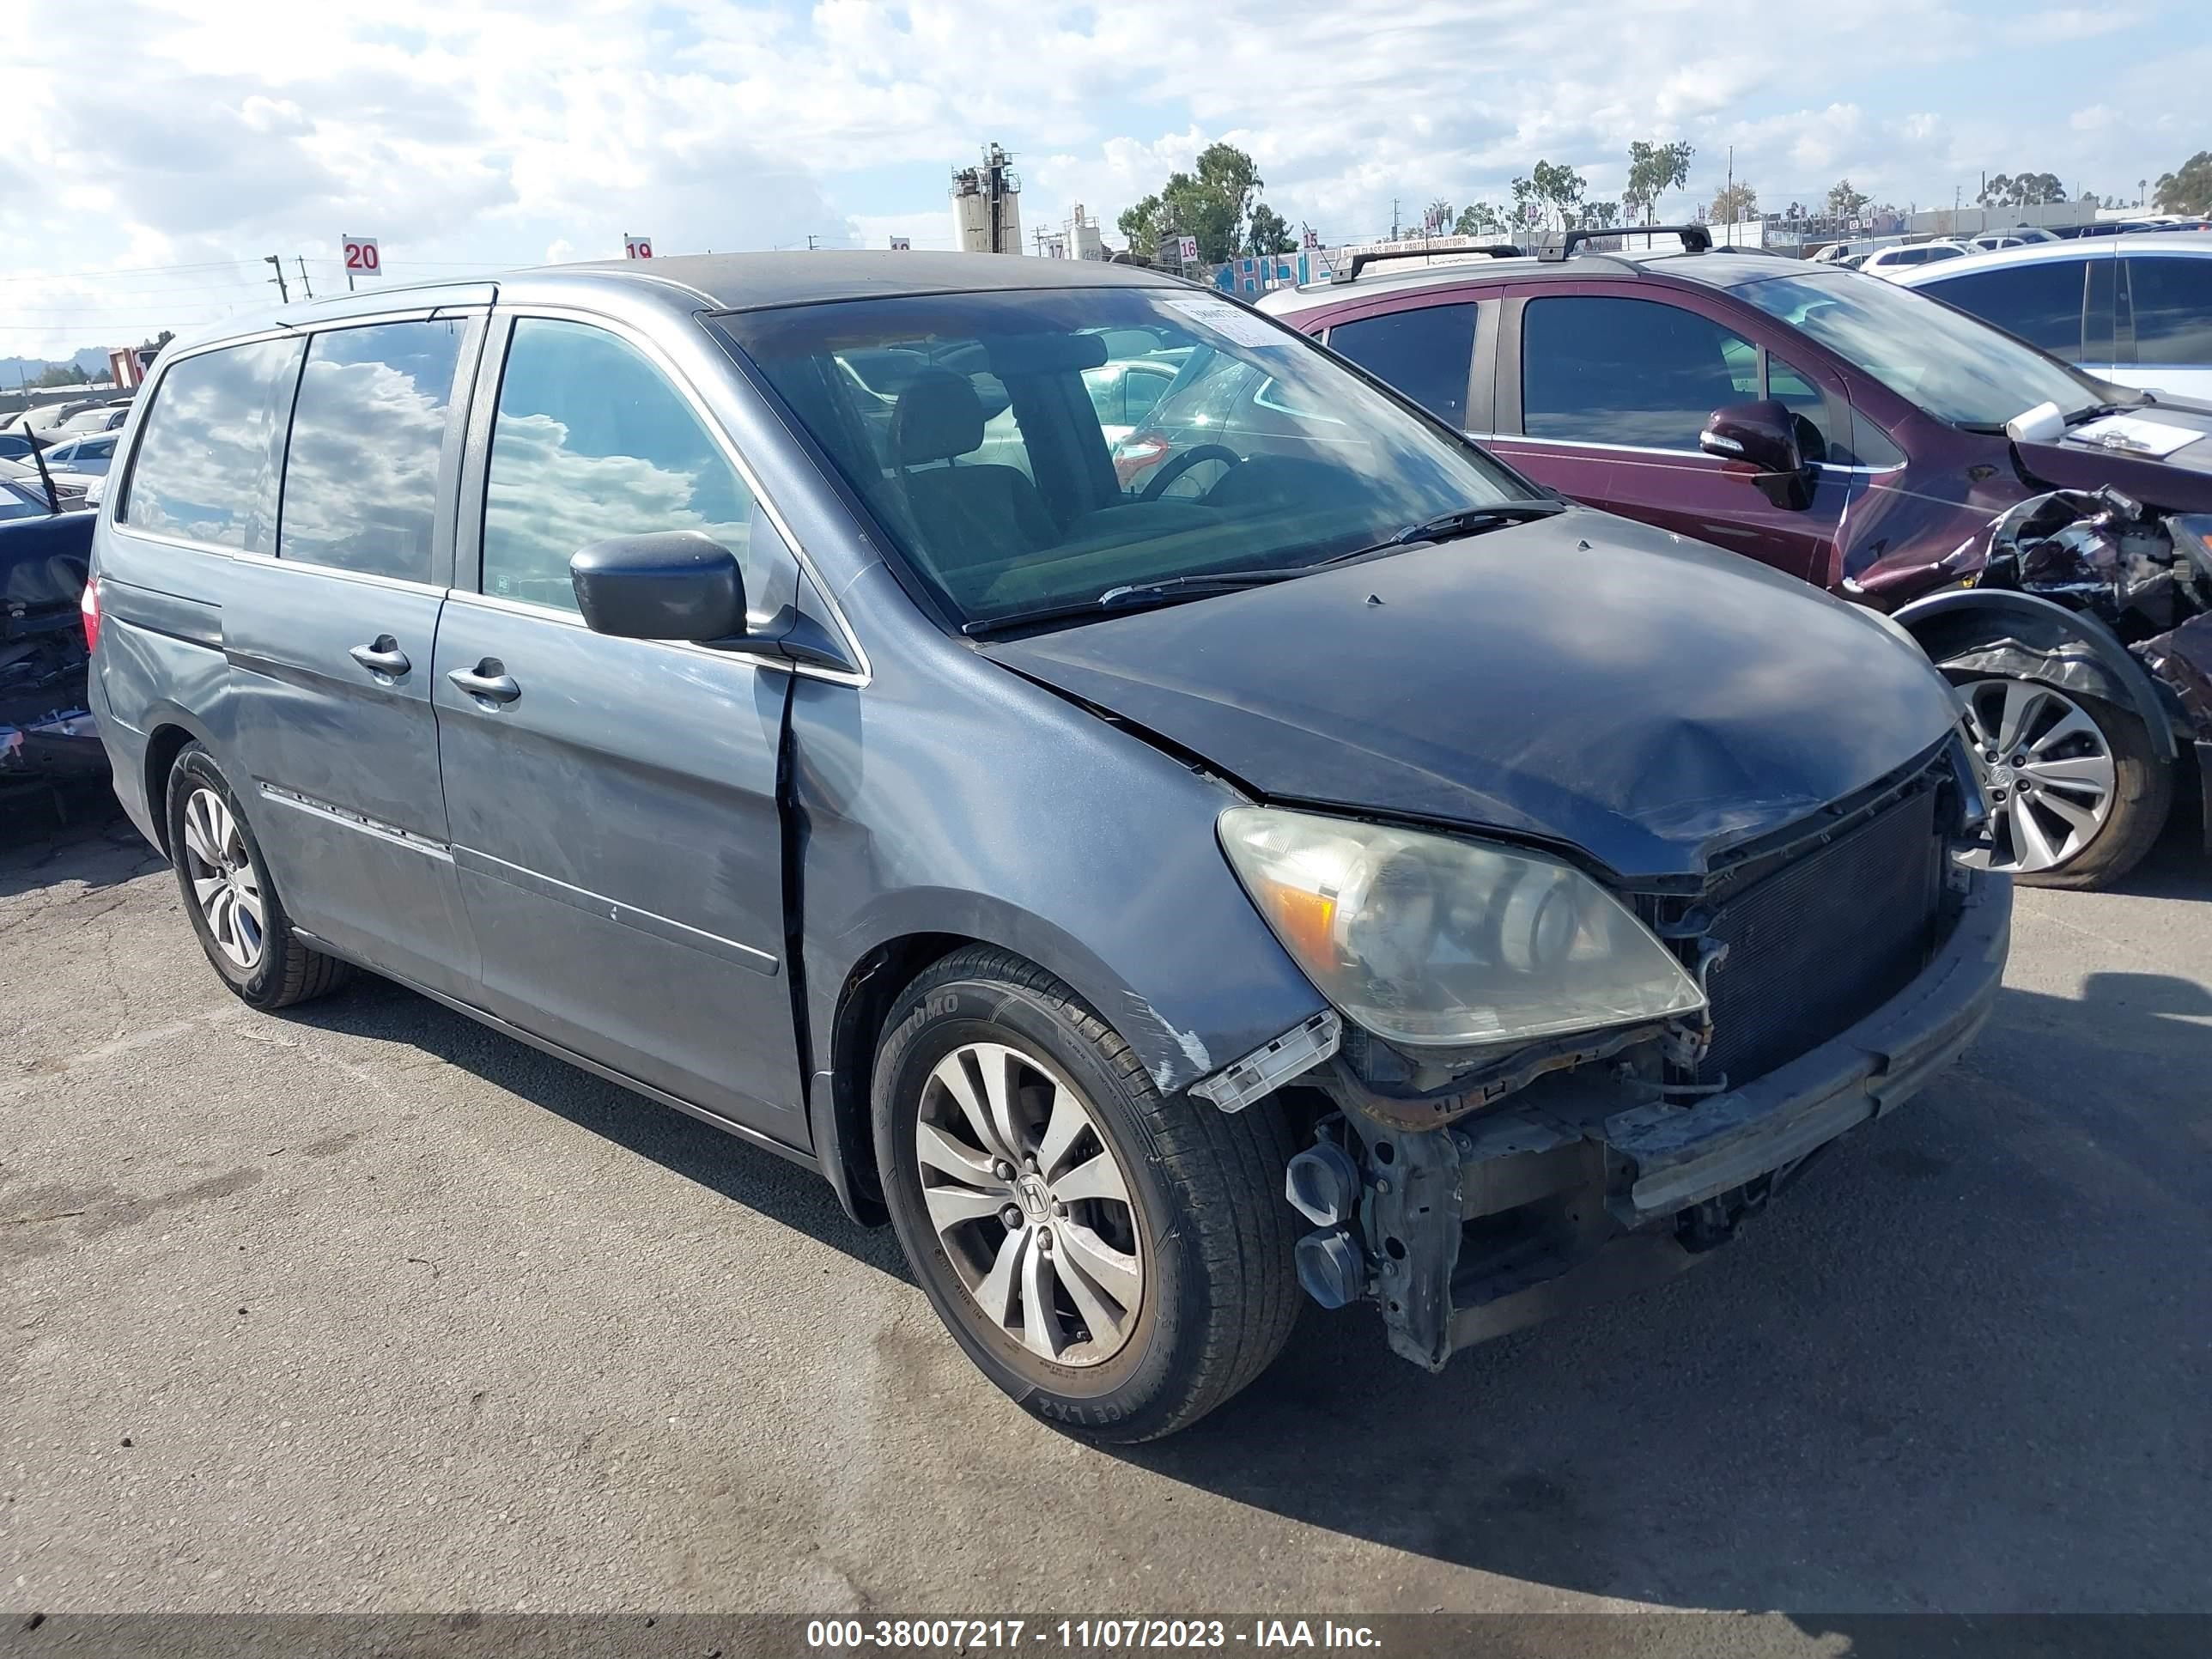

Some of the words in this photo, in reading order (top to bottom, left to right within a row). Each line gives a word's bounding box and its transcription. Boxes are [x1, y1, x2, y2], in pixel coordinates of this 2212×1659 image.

[1626, 206, 1635, 217] 12
[1425, 215, 1436, 229] 14
[1850, 221, 1857, 230] G
[1864, 220, 1870, 228] H
[1304, 234, 1317, 248] 15
[1429, 238, 1467, 248] RADIATORS
[627, 243, 652, 258] 19
[1049, 245, 1064, 258] 17
[1182, 240, 1196, 258] 16
[345, 244, 378, 269] 20
